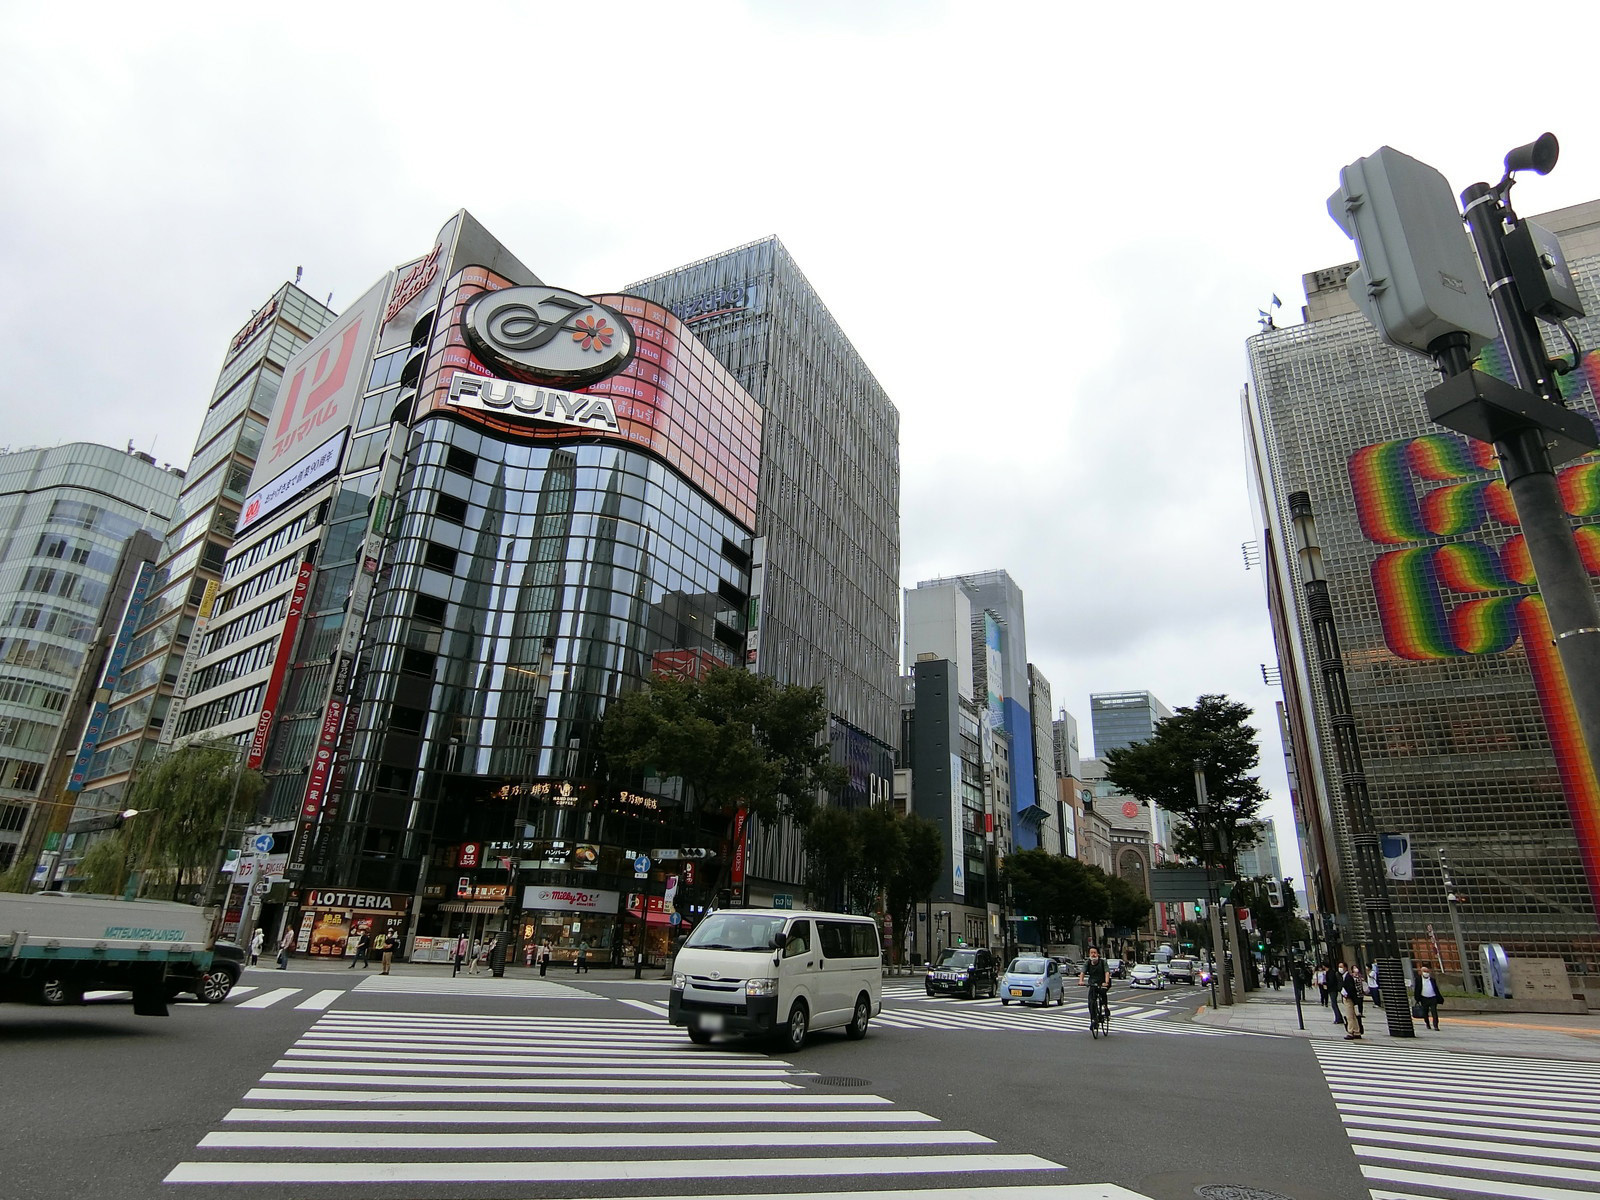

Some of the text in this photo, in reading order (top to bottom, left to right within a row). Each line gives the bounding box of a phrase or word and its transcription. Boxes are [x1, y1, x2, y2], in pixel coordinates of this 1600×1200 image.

[391, 243, 443, 301] カラオケ
[450, 375, 617, 429] FUJIYA
[289, 570, 311, 616] カラオケ
[309, 761, 326, 801] 不二家
[870, 773, 890, 812] GAP
[297, 829, 308, 863] LOTTERIA
[317, 892, 392, 909] LOTTERIA
[387, 918, 402, 926] B1F
